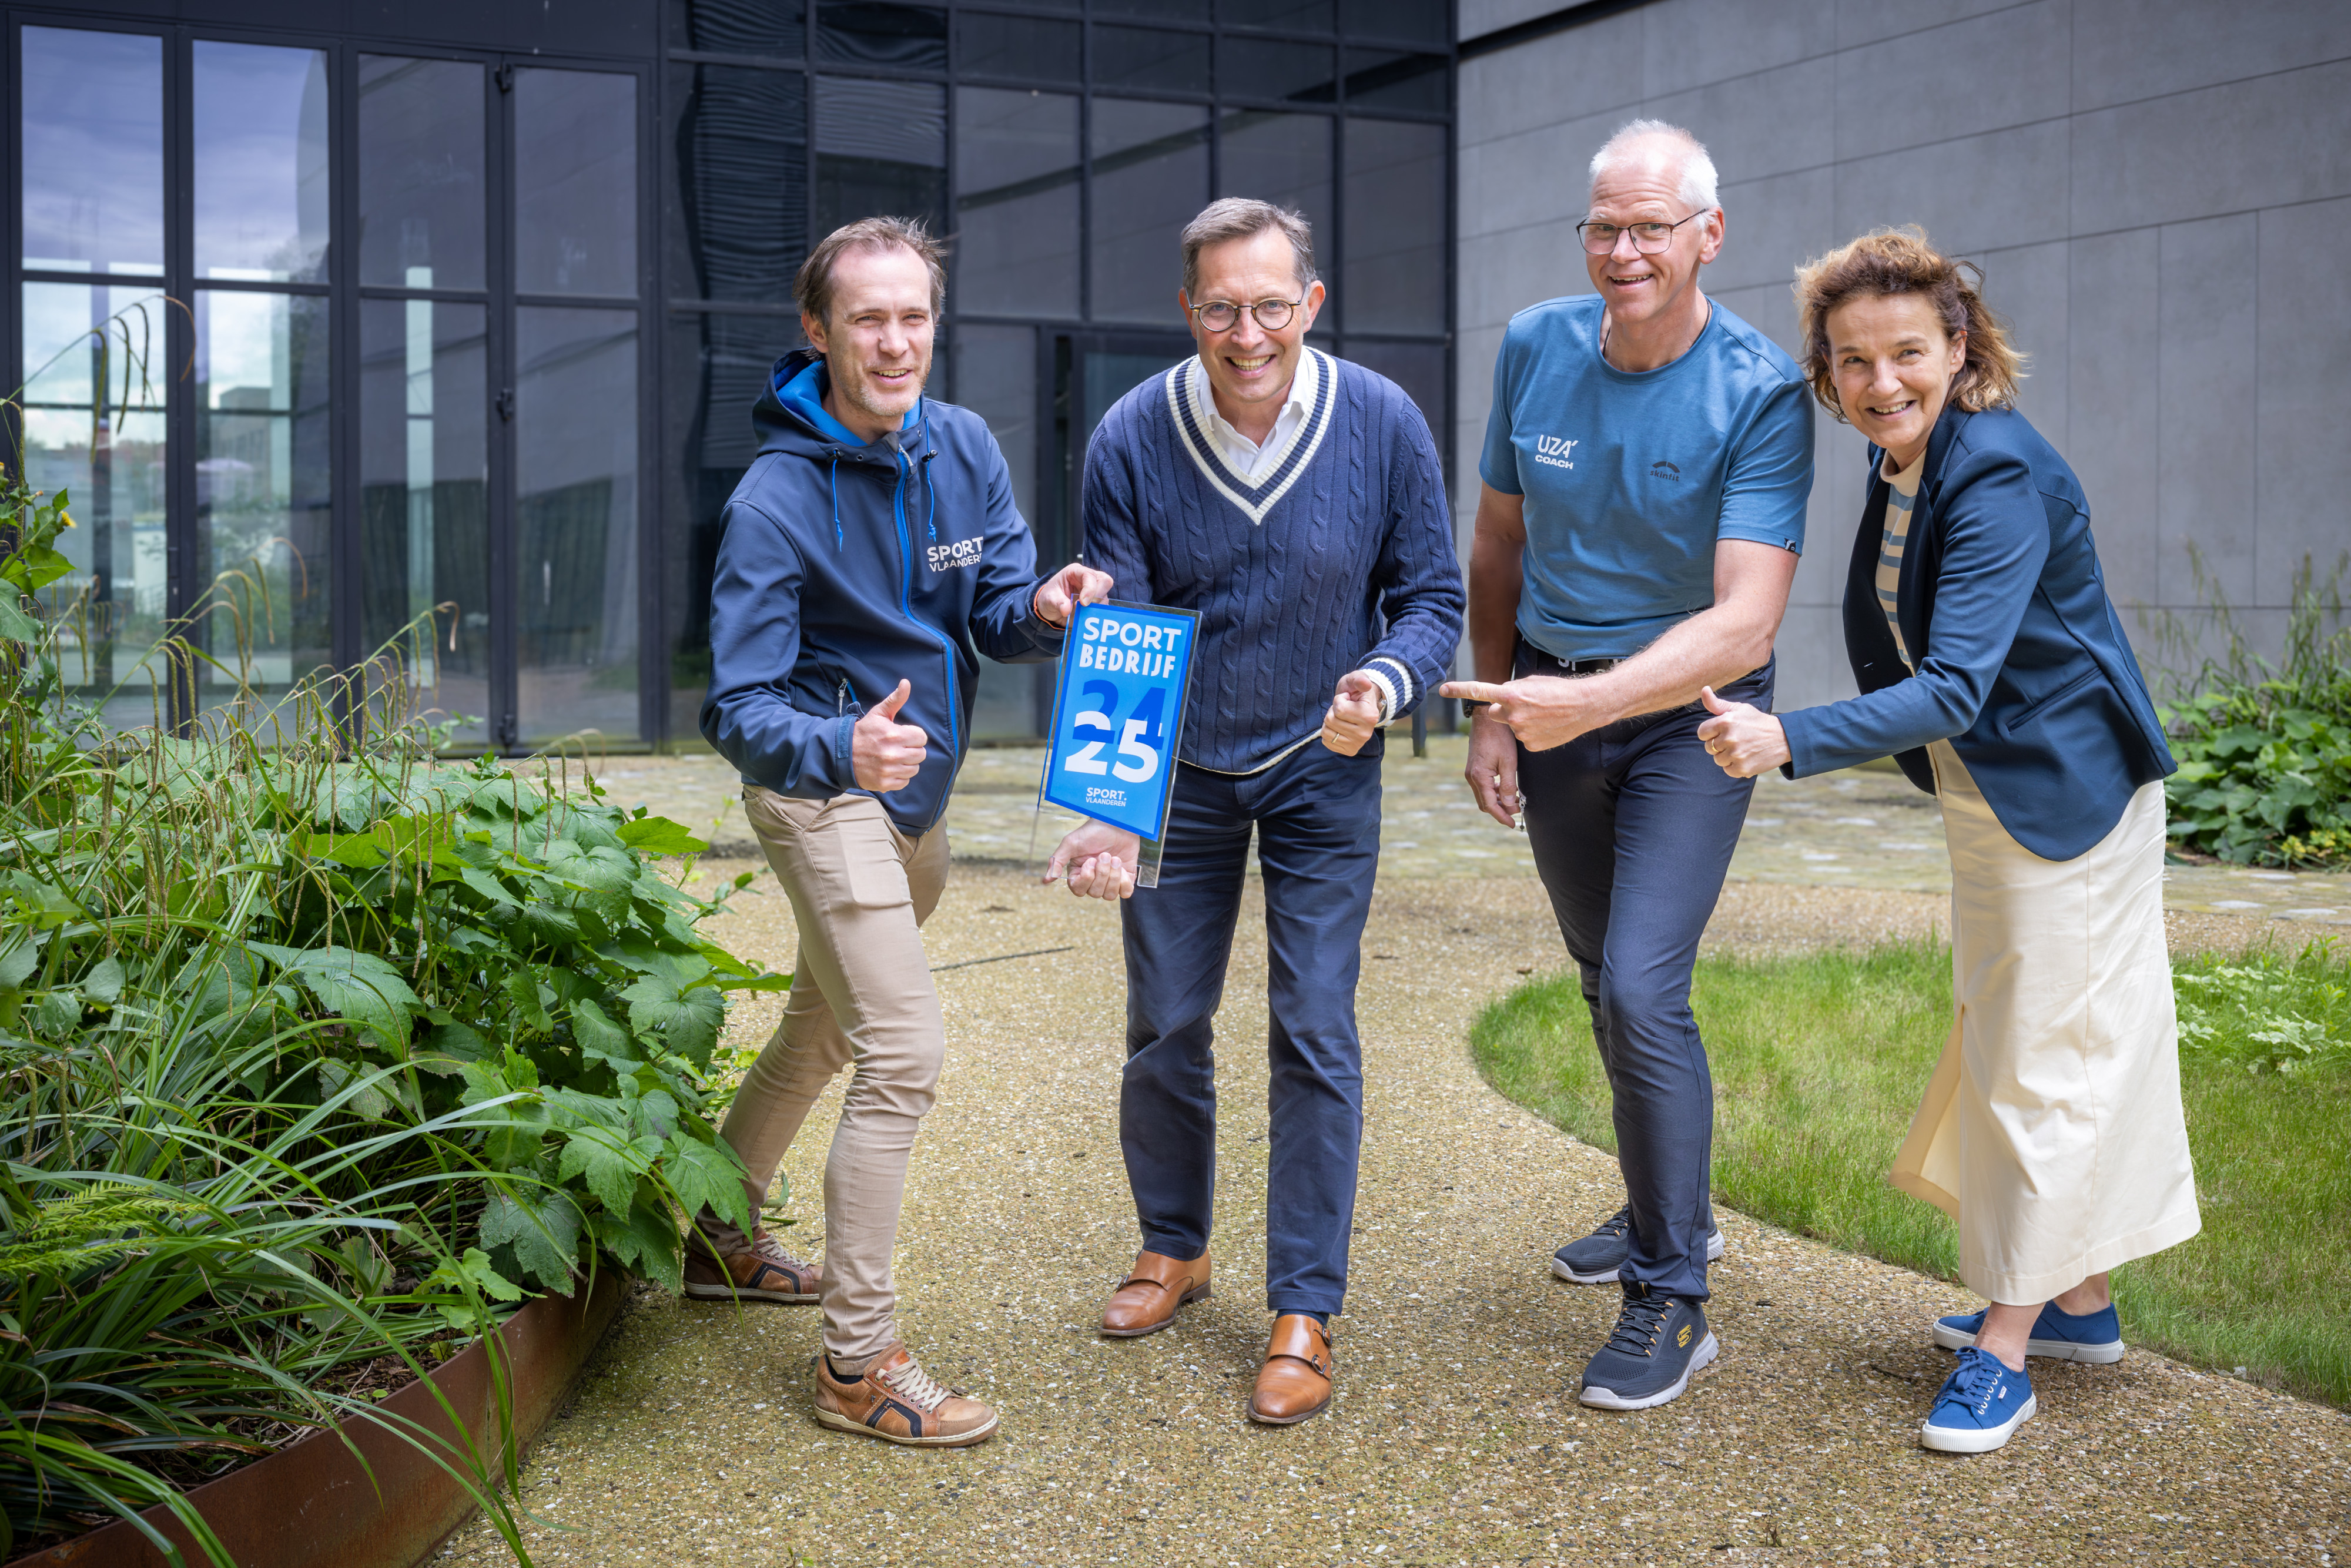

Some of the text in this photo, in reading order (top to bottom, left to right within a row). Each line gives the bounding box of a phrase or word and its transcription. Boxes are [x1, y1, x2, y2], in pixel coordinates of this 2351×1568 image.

[1535, 454, 1574, 470] COACH
[1650, 470, 1679, 482] skinfit
[927, 536, 984, 562] SPORT
[1083, 617, 1182, 652] SPORT
[1079, 643, 1176, 678] BEDRIJF
[1072, 679, 1166, 751] 24
[1064, 711, 1162, 783] 25
[1086, 797, 1126, 807] VLAANDEREN
